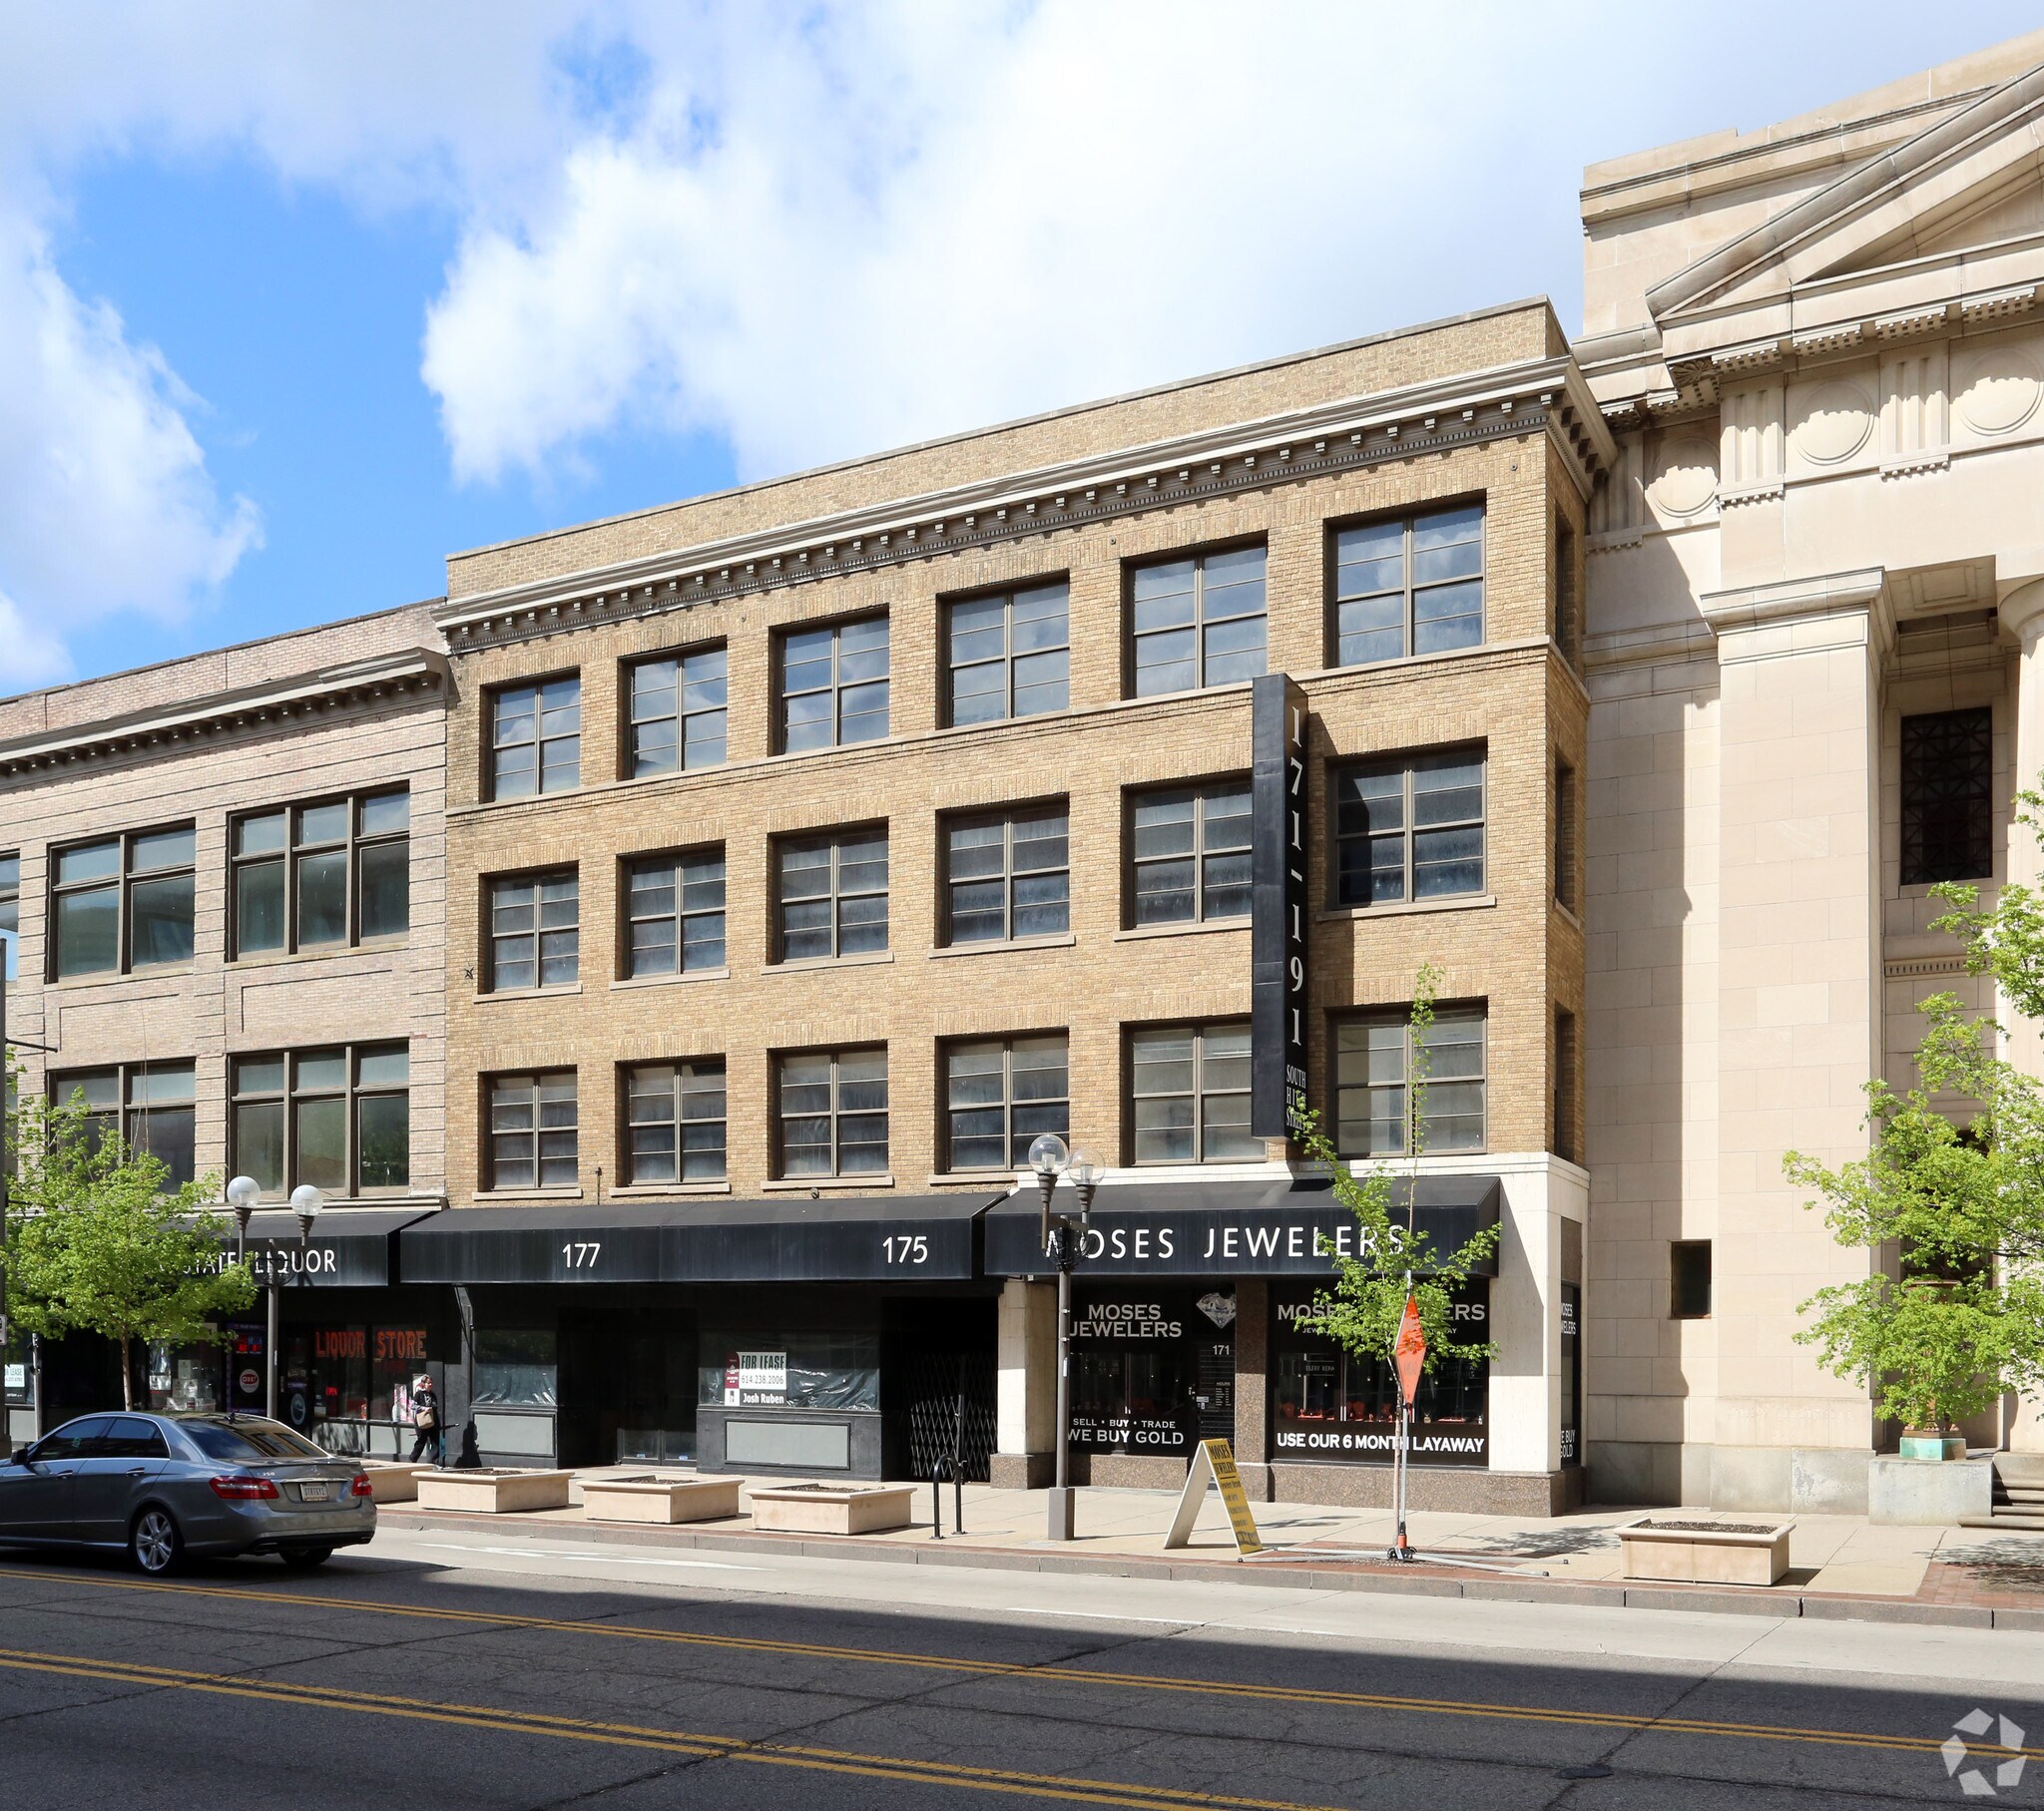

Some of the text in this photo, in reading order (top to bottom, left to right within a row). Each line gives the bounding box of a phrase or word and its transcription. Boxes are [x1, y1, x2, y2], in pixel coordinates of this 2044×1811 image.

[1289, 705, 1304, 1047] 171-191
[1286, 1064, 1306, 1089] SOUTH
[881, 1235, 929, 1264] 175
[1203, 1224, 1404, 1258] JEWELERS
[255, 1249, 337, 1273] LIQUOR
[562, 1242, 602, 1268] 177
[1088, 1304, 1161, 1320] MOSES
[1278, 1303, 1342, 1322] MOSE
[1069, 1321, 1182, 1337] JEWELERS
[315, 1330, 427, 1359] LIQUOR STORE
[1213, 1344, 1230, 1355] 171
[741, 1355, 785, 1371] FOR LEASE
[741, 1375, 784, 1385] 614.238.2006
[743, 1392, 784, 1405] Josh Ruben
[1068, 1429, 1185, 1445] WE BUY GOLD
[1277, 1432, 1485, 1453] USE OUR 6 MONTH LAYAWAY
[1208, 1444, 1231, 1460] MOSES
